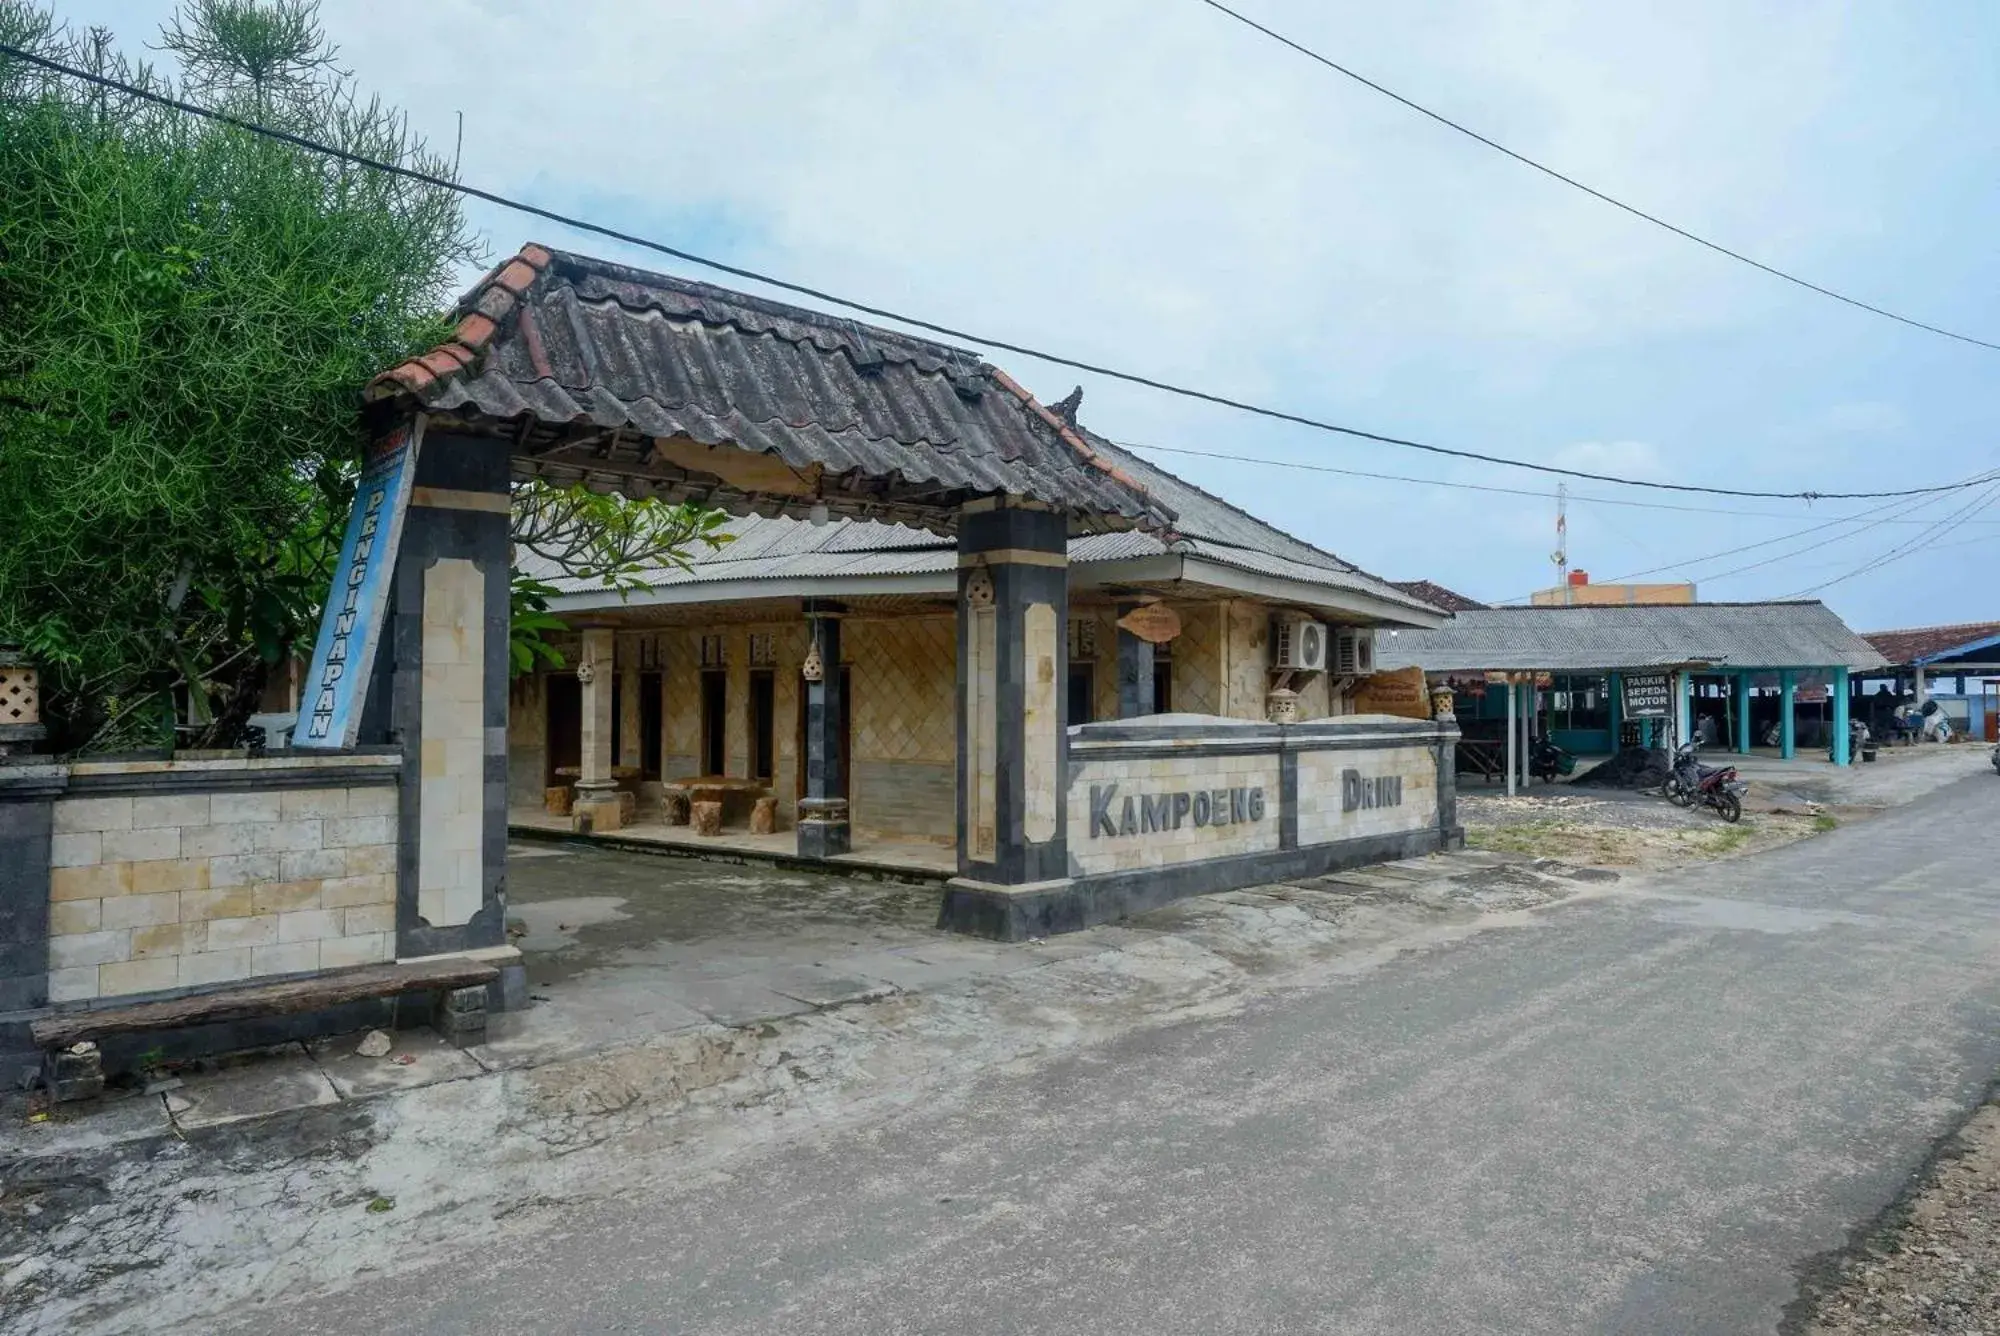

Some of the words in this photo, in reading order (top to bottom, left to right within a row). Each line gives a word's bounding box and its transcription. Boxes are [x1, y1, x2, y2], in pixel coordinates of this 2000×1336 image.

[309, 490, 385, 738] PENGINAPAN
[1627, 676, 1665, 686] PARKIR
[1627, 686, 1668, 697] SEPEDA
[1629, 696, 1668, 706] MOTOR
[1090, 783, 1265, 839] KAMPOENG
